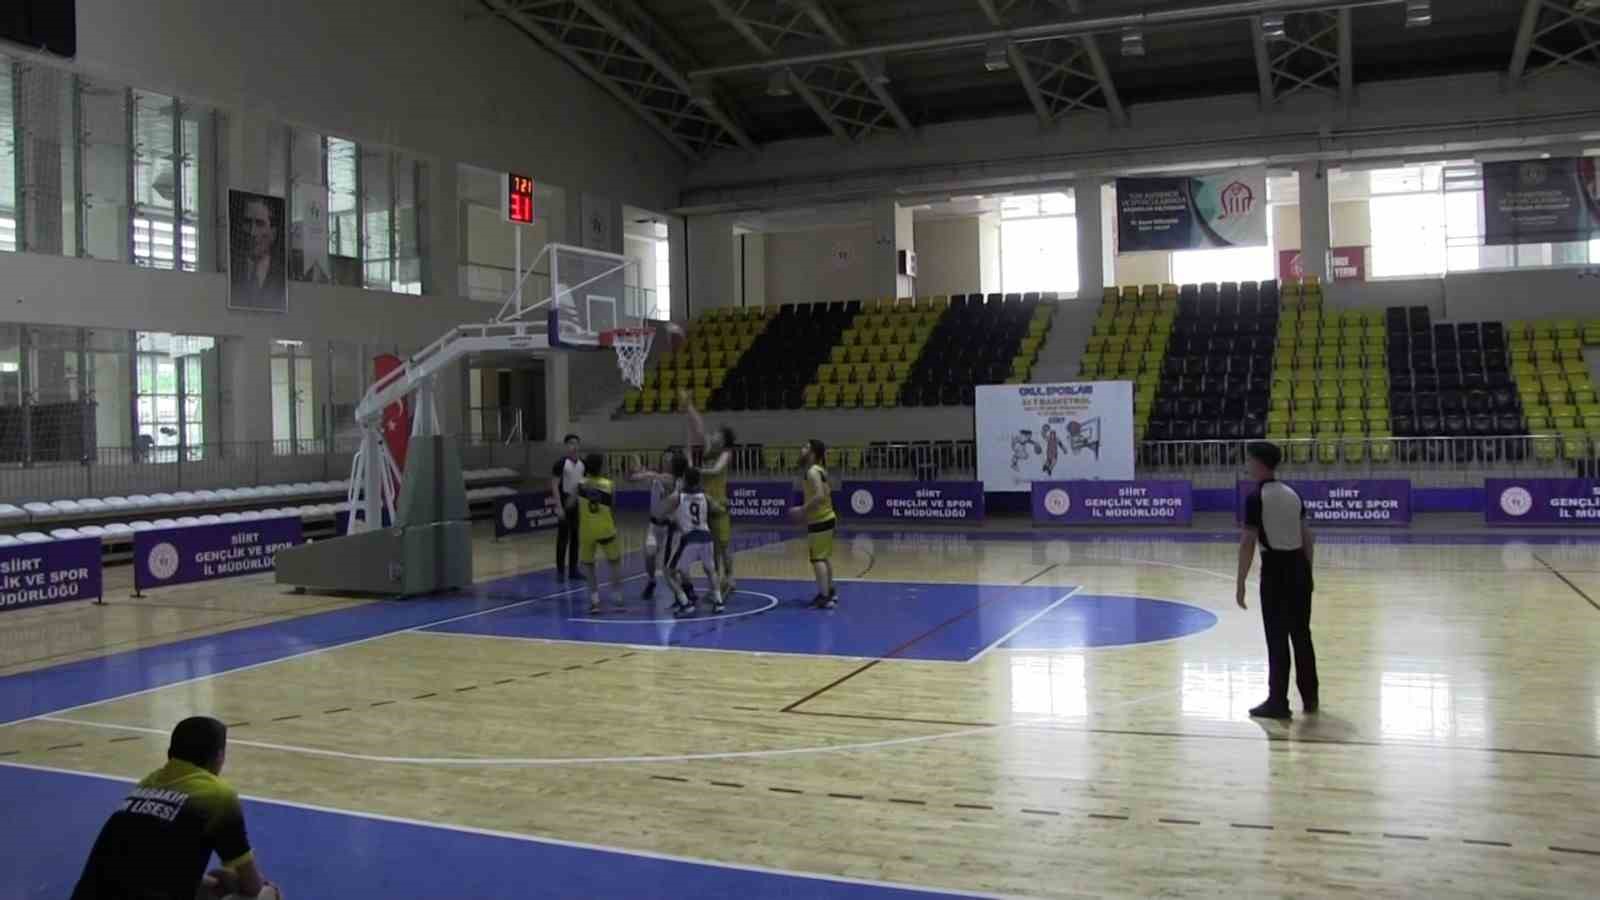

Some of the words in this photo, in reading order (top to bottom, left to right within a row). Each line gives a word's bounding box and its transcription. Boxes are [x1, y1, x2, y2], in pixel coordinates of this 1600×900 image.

[946, 500, 973, 508] SPOR
[1084, 498, 1132, 508] GENÇLİK
[1135, 498, 1149, 506] VE
[1152, 498, 1182, 507] SPOR
[1346, 500, 1362, 508] VE
[1366, 500, 1398, 508] SPOR
[1550, 497, 1600, 508] GENÇLİ
[689, 503, 701, 525] 9
[195, 547, 245, 563] GENÇLİK
[248, 545, 262, 556] VE
[0, 557, 41, 574] SİİRT
[203, 562, 215, 575] İL
[25, 573, 45, 586] VE
[50, 568, 88, 583] SPOR
